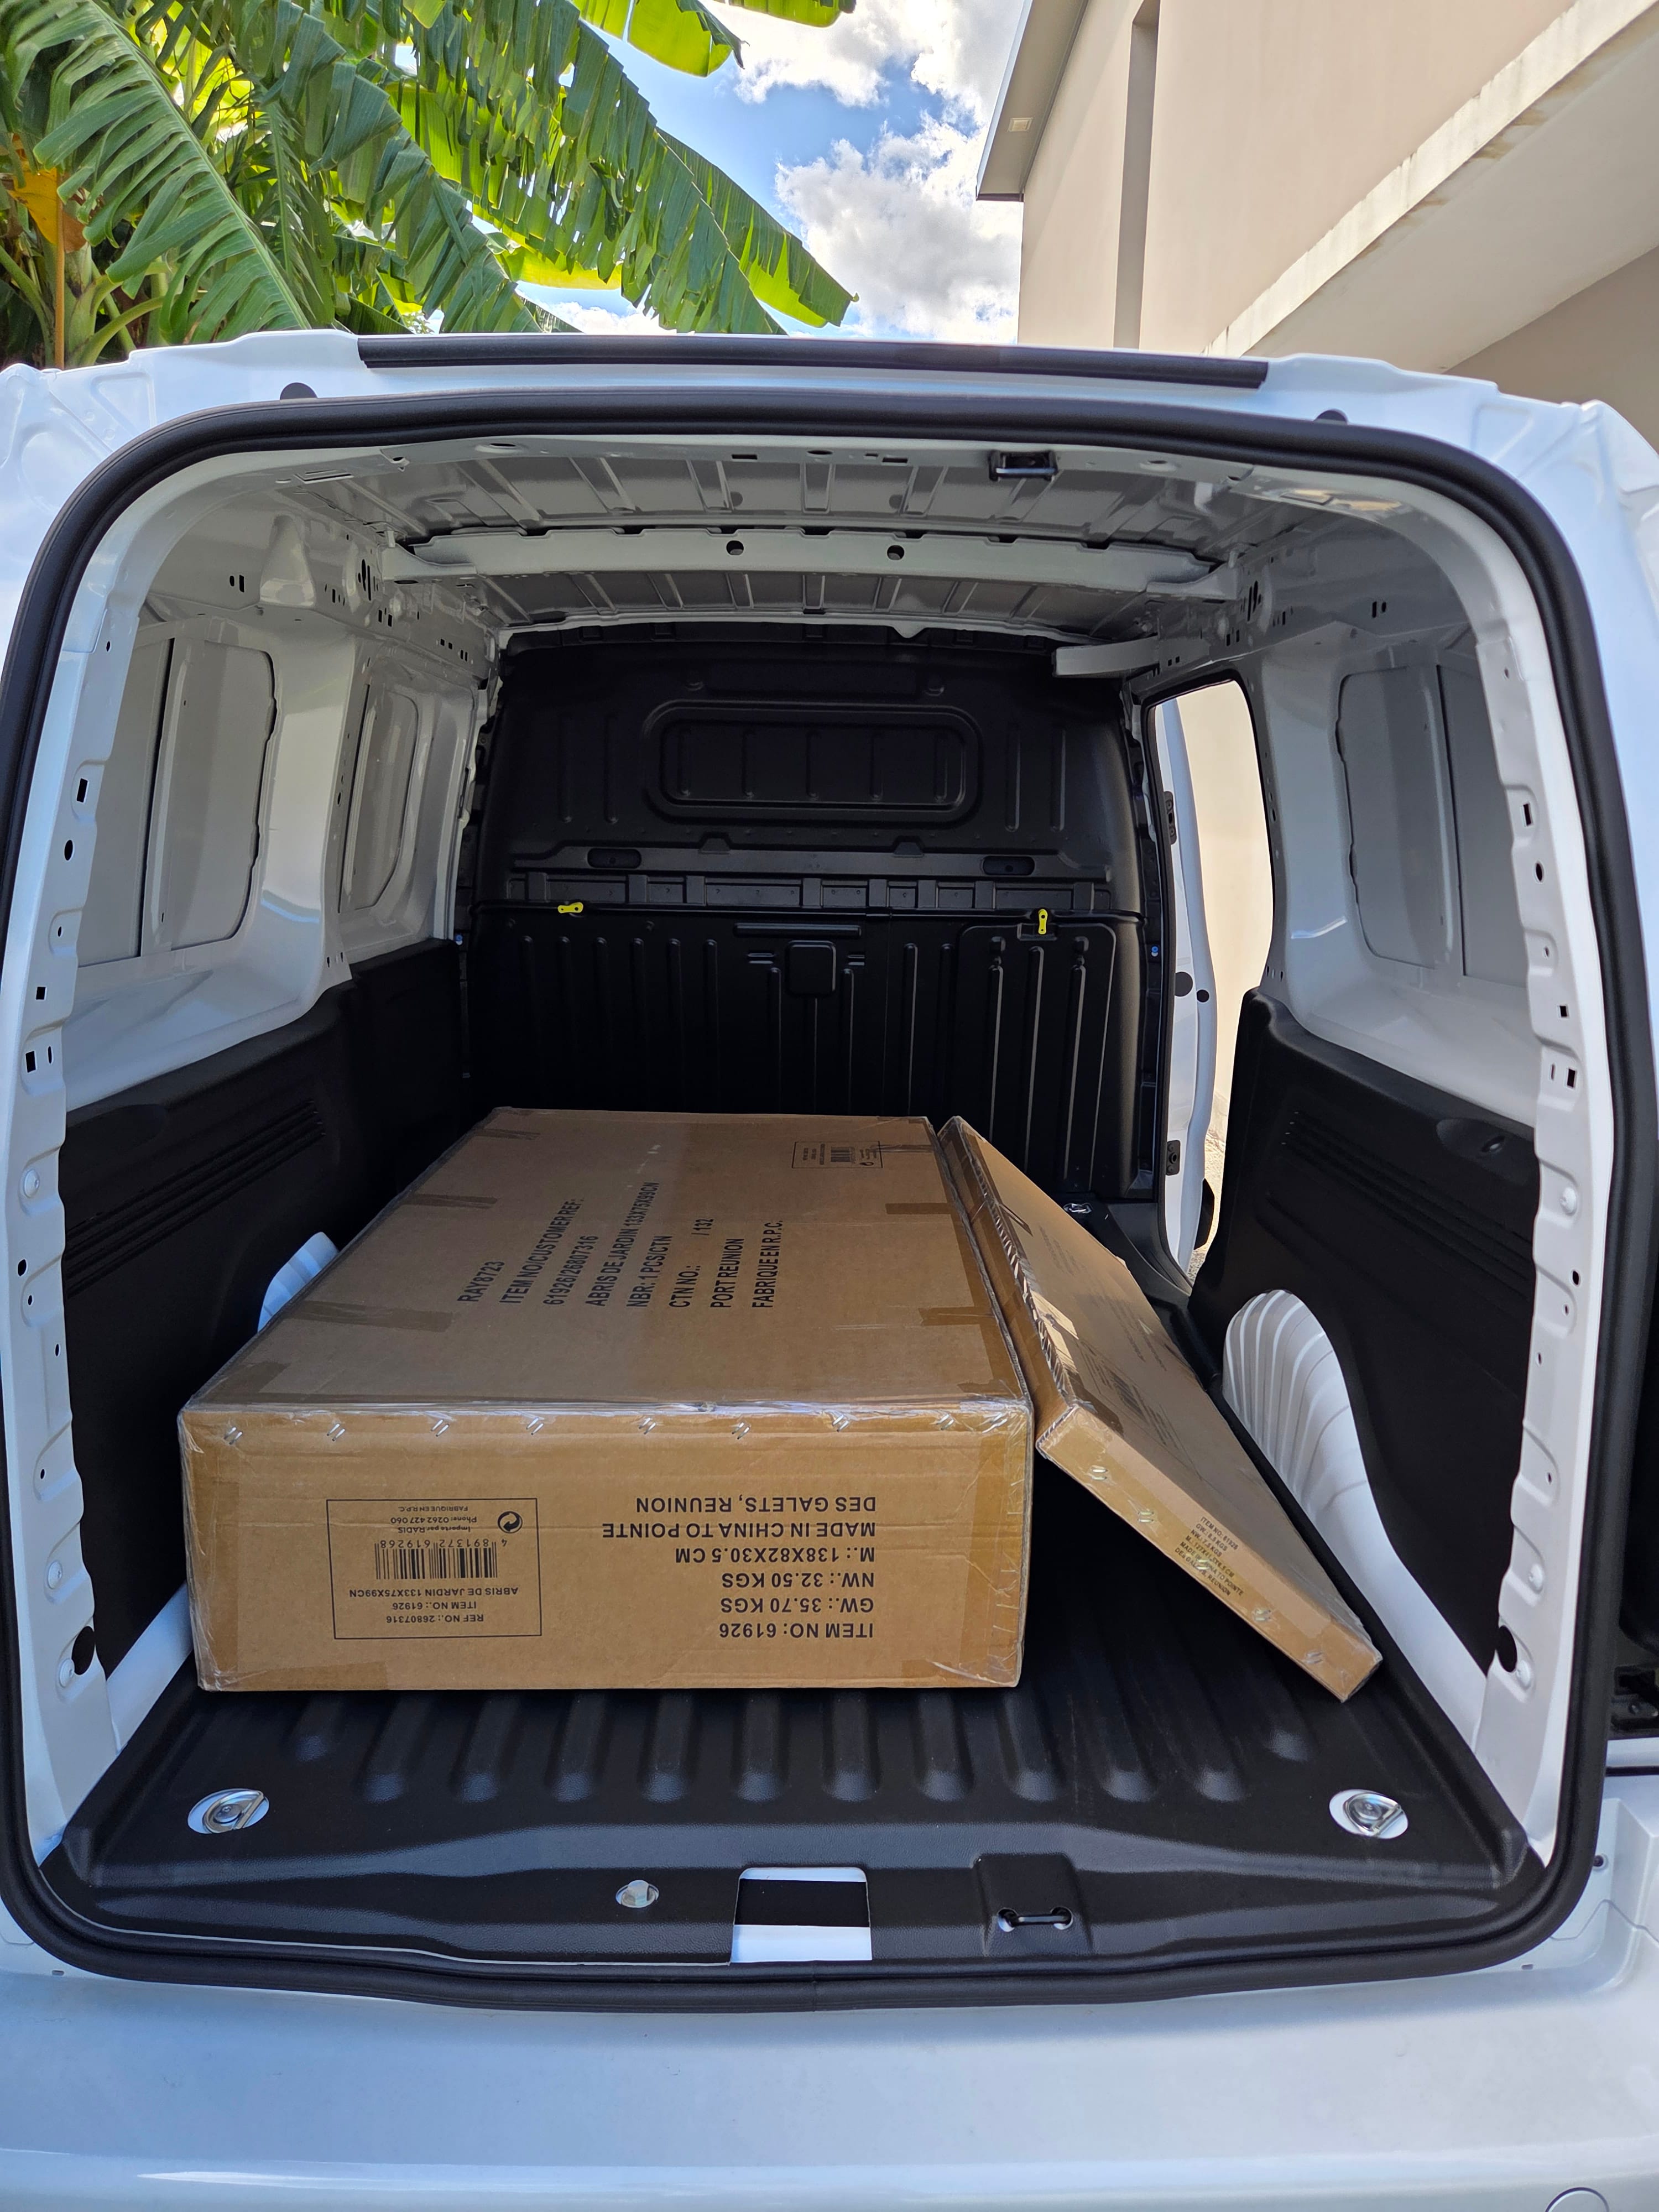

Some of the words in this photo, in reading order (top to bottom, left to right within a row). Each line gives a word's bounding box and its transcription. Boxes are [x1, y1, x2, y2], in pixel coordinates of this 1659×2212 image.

[624, 1182, 659, 1226] 133X75X99CN
[762, 1221, 782, 1243] R.P.C.
[499, 1280, 534, 1303] ITEM
[517, 1217, 573, 1277] NO/CUSTOMER
[557, 1199, 583, 1215] REF:
[609, 1229, 639, 1260] JARDIN
[760, 1245, 780, 1256] EN
[640, 1237, 672, 1272] PCS/CTN
[717, 1239, 744, 1277] REUNION
[543, 1236, 598, 1305] 61926/26807316
[601, 1262, 624, 1273] DE
[457, 1262, 504, 1302] RAY8723
[676, 1266, 701, 1285] NO.:
[752, 1259, 778, 1307] FABRIQUE
[586, 1276, 617, 1306] ABRIS
[627, 1283, 656, 1307] NBR:
[669, 1288, 695, 1307] CTN
[711, 1280, 735, 1307] PORT
[637, 1498, 731, 1512] REUNION
[739, 1495, 828, 1512] GALETS,
[836, 1497, 875, 1511] DES
[686, 1524, 713, 1537] TO
[718, 1523, 784, 1537] CHINA
[791, 1523, 809, 1537] IN
[816, 1522, 875, 1537] MADE
[1201, 1517, 1214, 1529] ITEM
[603, 1524, 679, 1538] POINTE
[380, 1540, 430, 1549] 619268
[440, 1539, 489, 1548] 891372
[1215, 1540, 1228, 1551] KGS
[676, 1548, 705, 1563] CM
[712, 1548, 839, 1562] 138X82X30.5
[847, 1547, 874, 1562] M.:
[1210, 1546, 1222, 1557] KGS
[1180, 1542, 1196, 1556] MADE
[1218, 1572, 1225, 1580] TO
[1225, 1578, 1244, 1596] POINTE
[1225, 1569, 1234, 1577] CM
[722, 1573, 764, 1588] KGS
[772, 1573, 823, 1587] 32.50
[831, 1573, 874, 1587] NW.:
[1208, 1574, 1231, 1595] REUNION
[721, 1598, 763, 1613] KGS
[770, 1598, 821, 1613] 35.70
[829, 1598, 873, 1613] GW.:
[719, 1623, 776, 1638] 61926
[784, 1623, 818, 1638] NO:
[826, 1623, 873, 1637] ITEM
